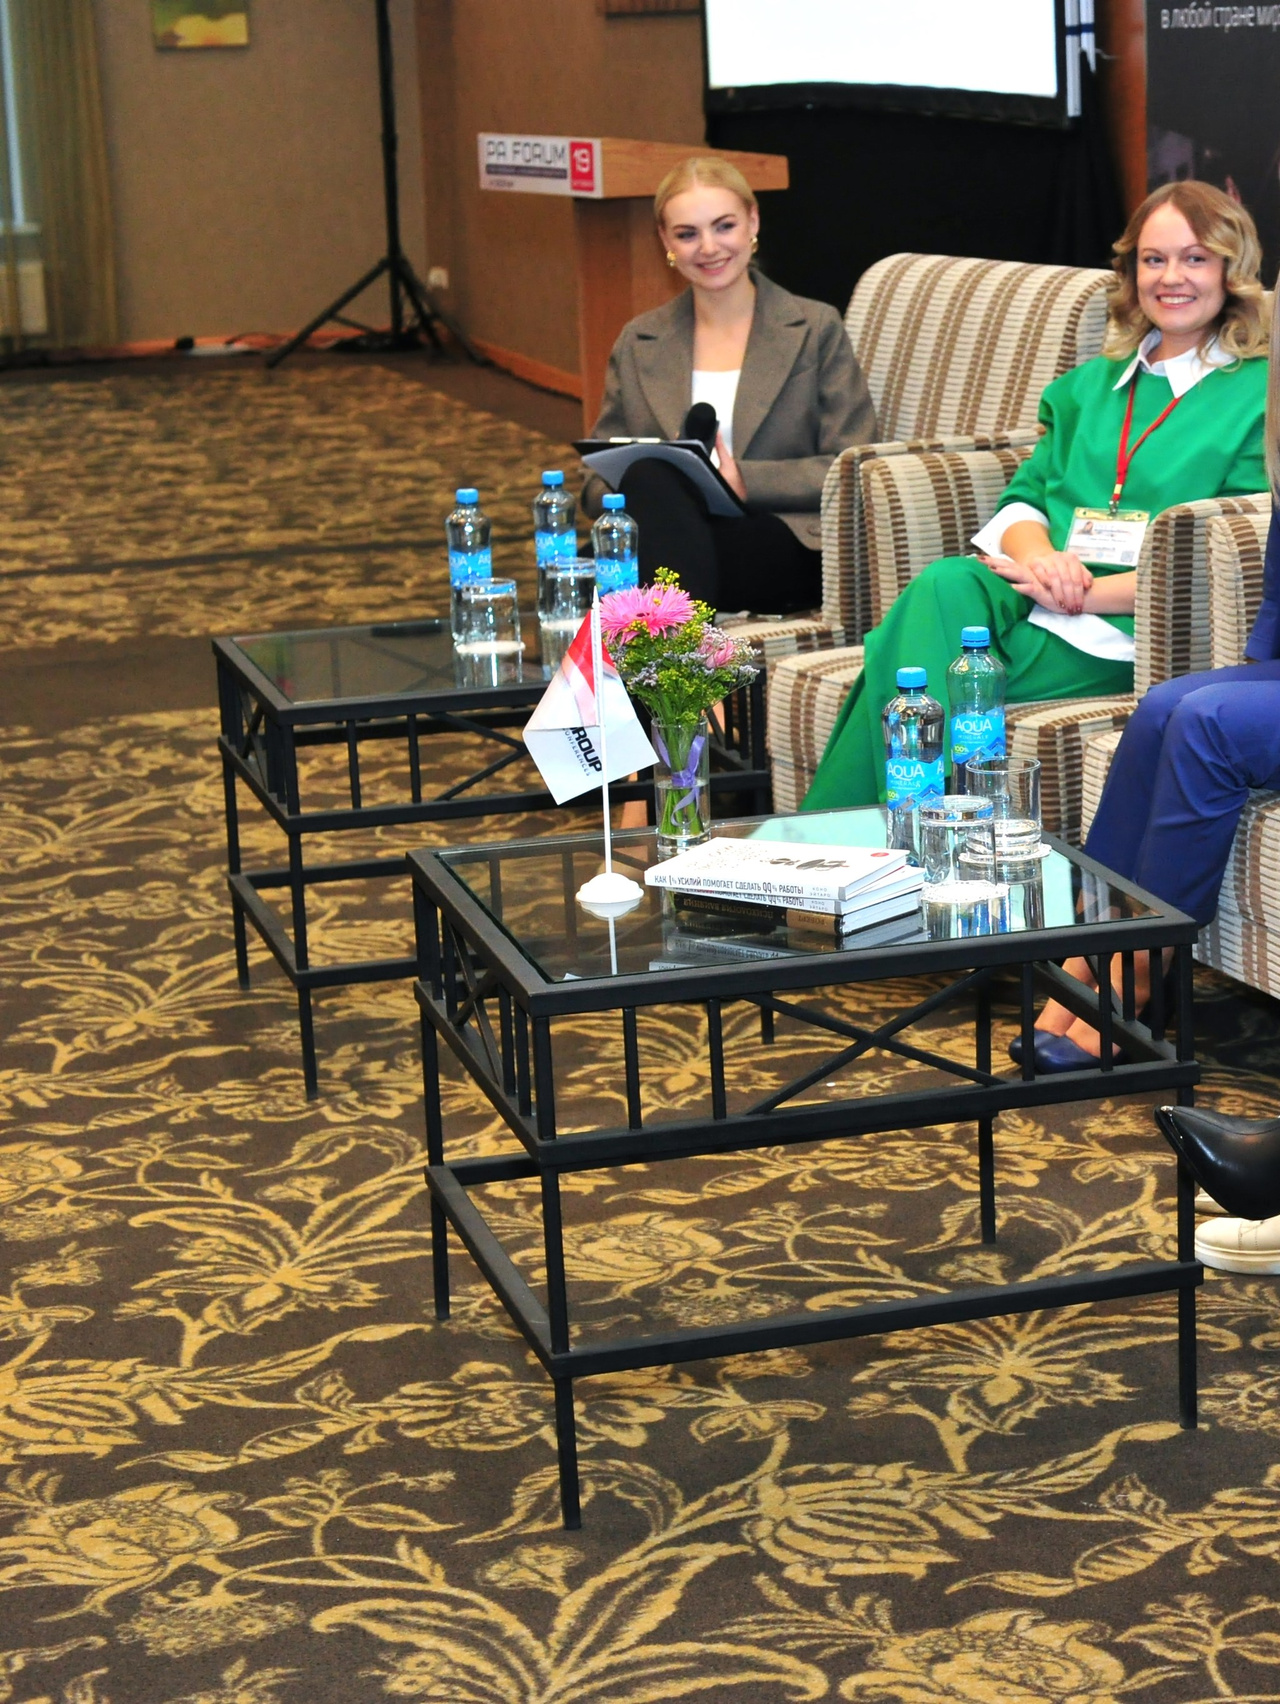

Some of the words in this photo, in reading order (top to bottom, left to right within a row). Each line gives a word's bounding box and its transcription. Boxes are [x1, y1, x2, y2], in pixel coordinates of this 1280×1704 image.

[1161, 9, 1170, 29] в
[1171, 1, 1212, 28] любой
[1213, 6, 1256, 33] стране
[512, 141, 567, 165] FORUM
[573, 148, 591, 173] 19
[955, 718, 993, 735] AQUA
[568, 727, 603, 772] ROUP
[887, 762, 925, 781] AQUA
[654, 875, 668, 884] КАК
[677, 876, 702, 887] УСИЛИЙ
[702, 878, 733, 889] ПОМОГАЕТ
[735, 881, 762, 891] СДЕЛАТЬ
[779, 884, 804, 895] РАБОТЫ
